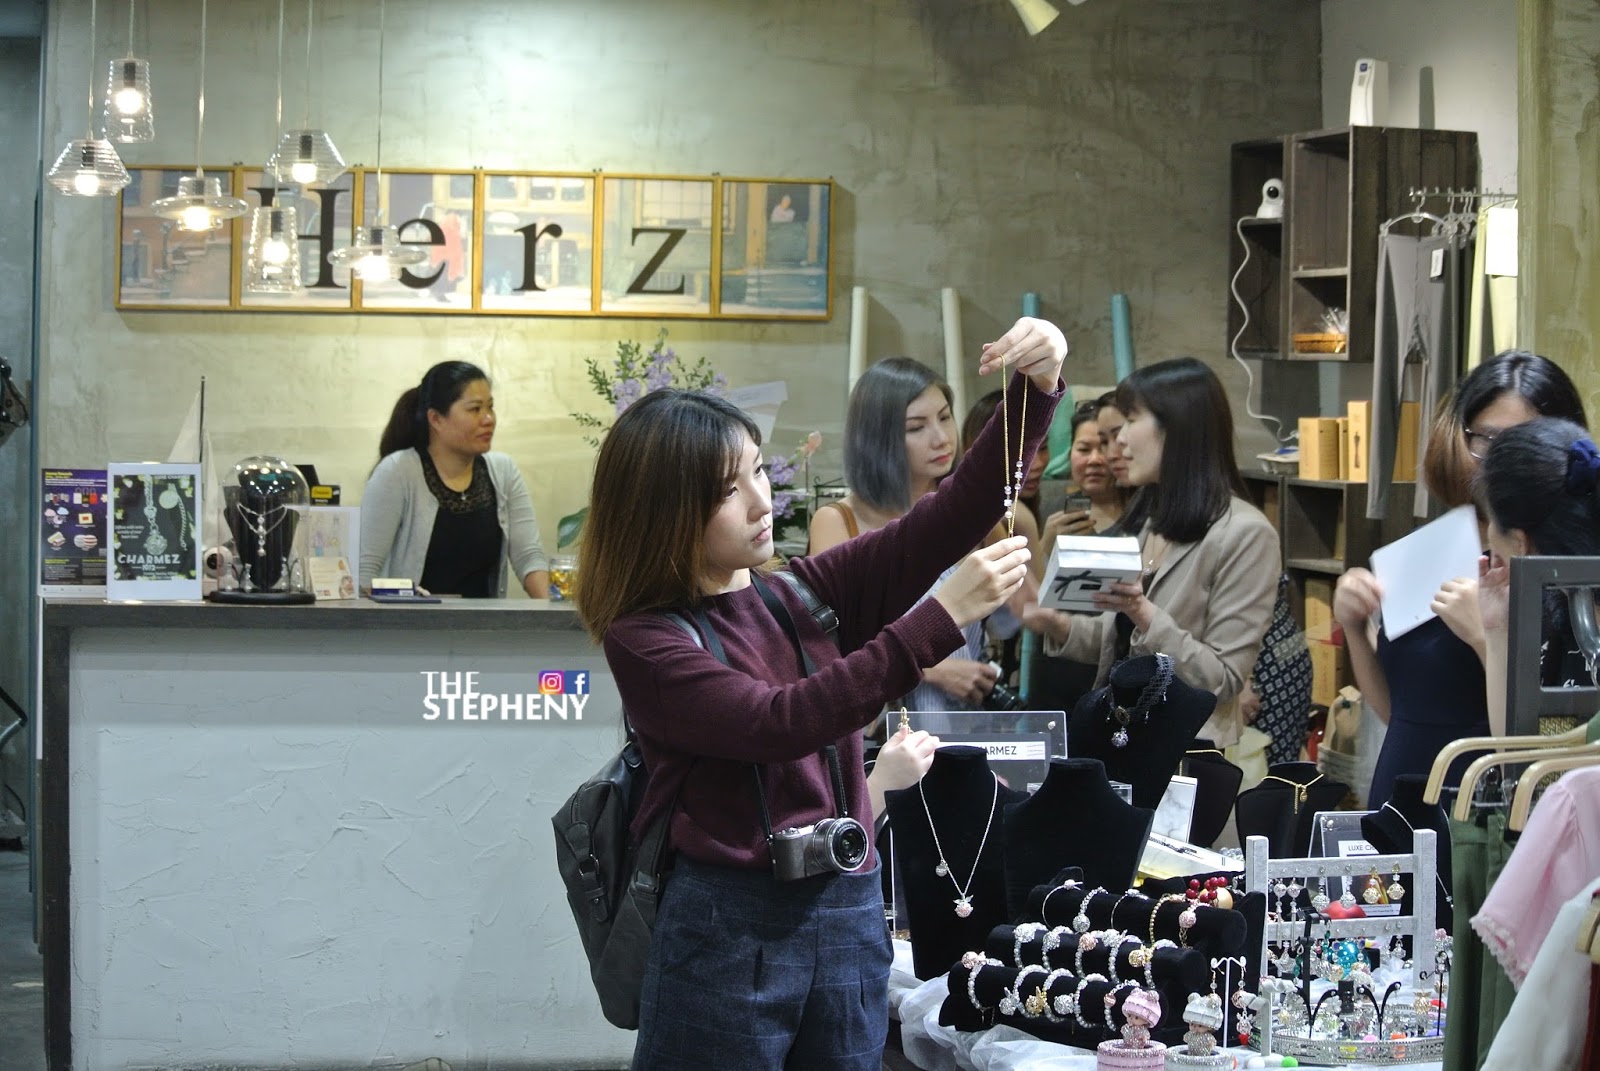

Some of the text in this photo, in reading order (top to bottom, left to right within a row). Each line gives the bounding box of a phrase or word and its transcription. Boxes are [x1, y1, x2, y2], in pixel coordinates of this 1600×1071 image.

[247, 187, 688, 295] Herz
[117, 554, 181, 565] CHARMEZ
[984, 746, 1017, 755] ARMEZ
